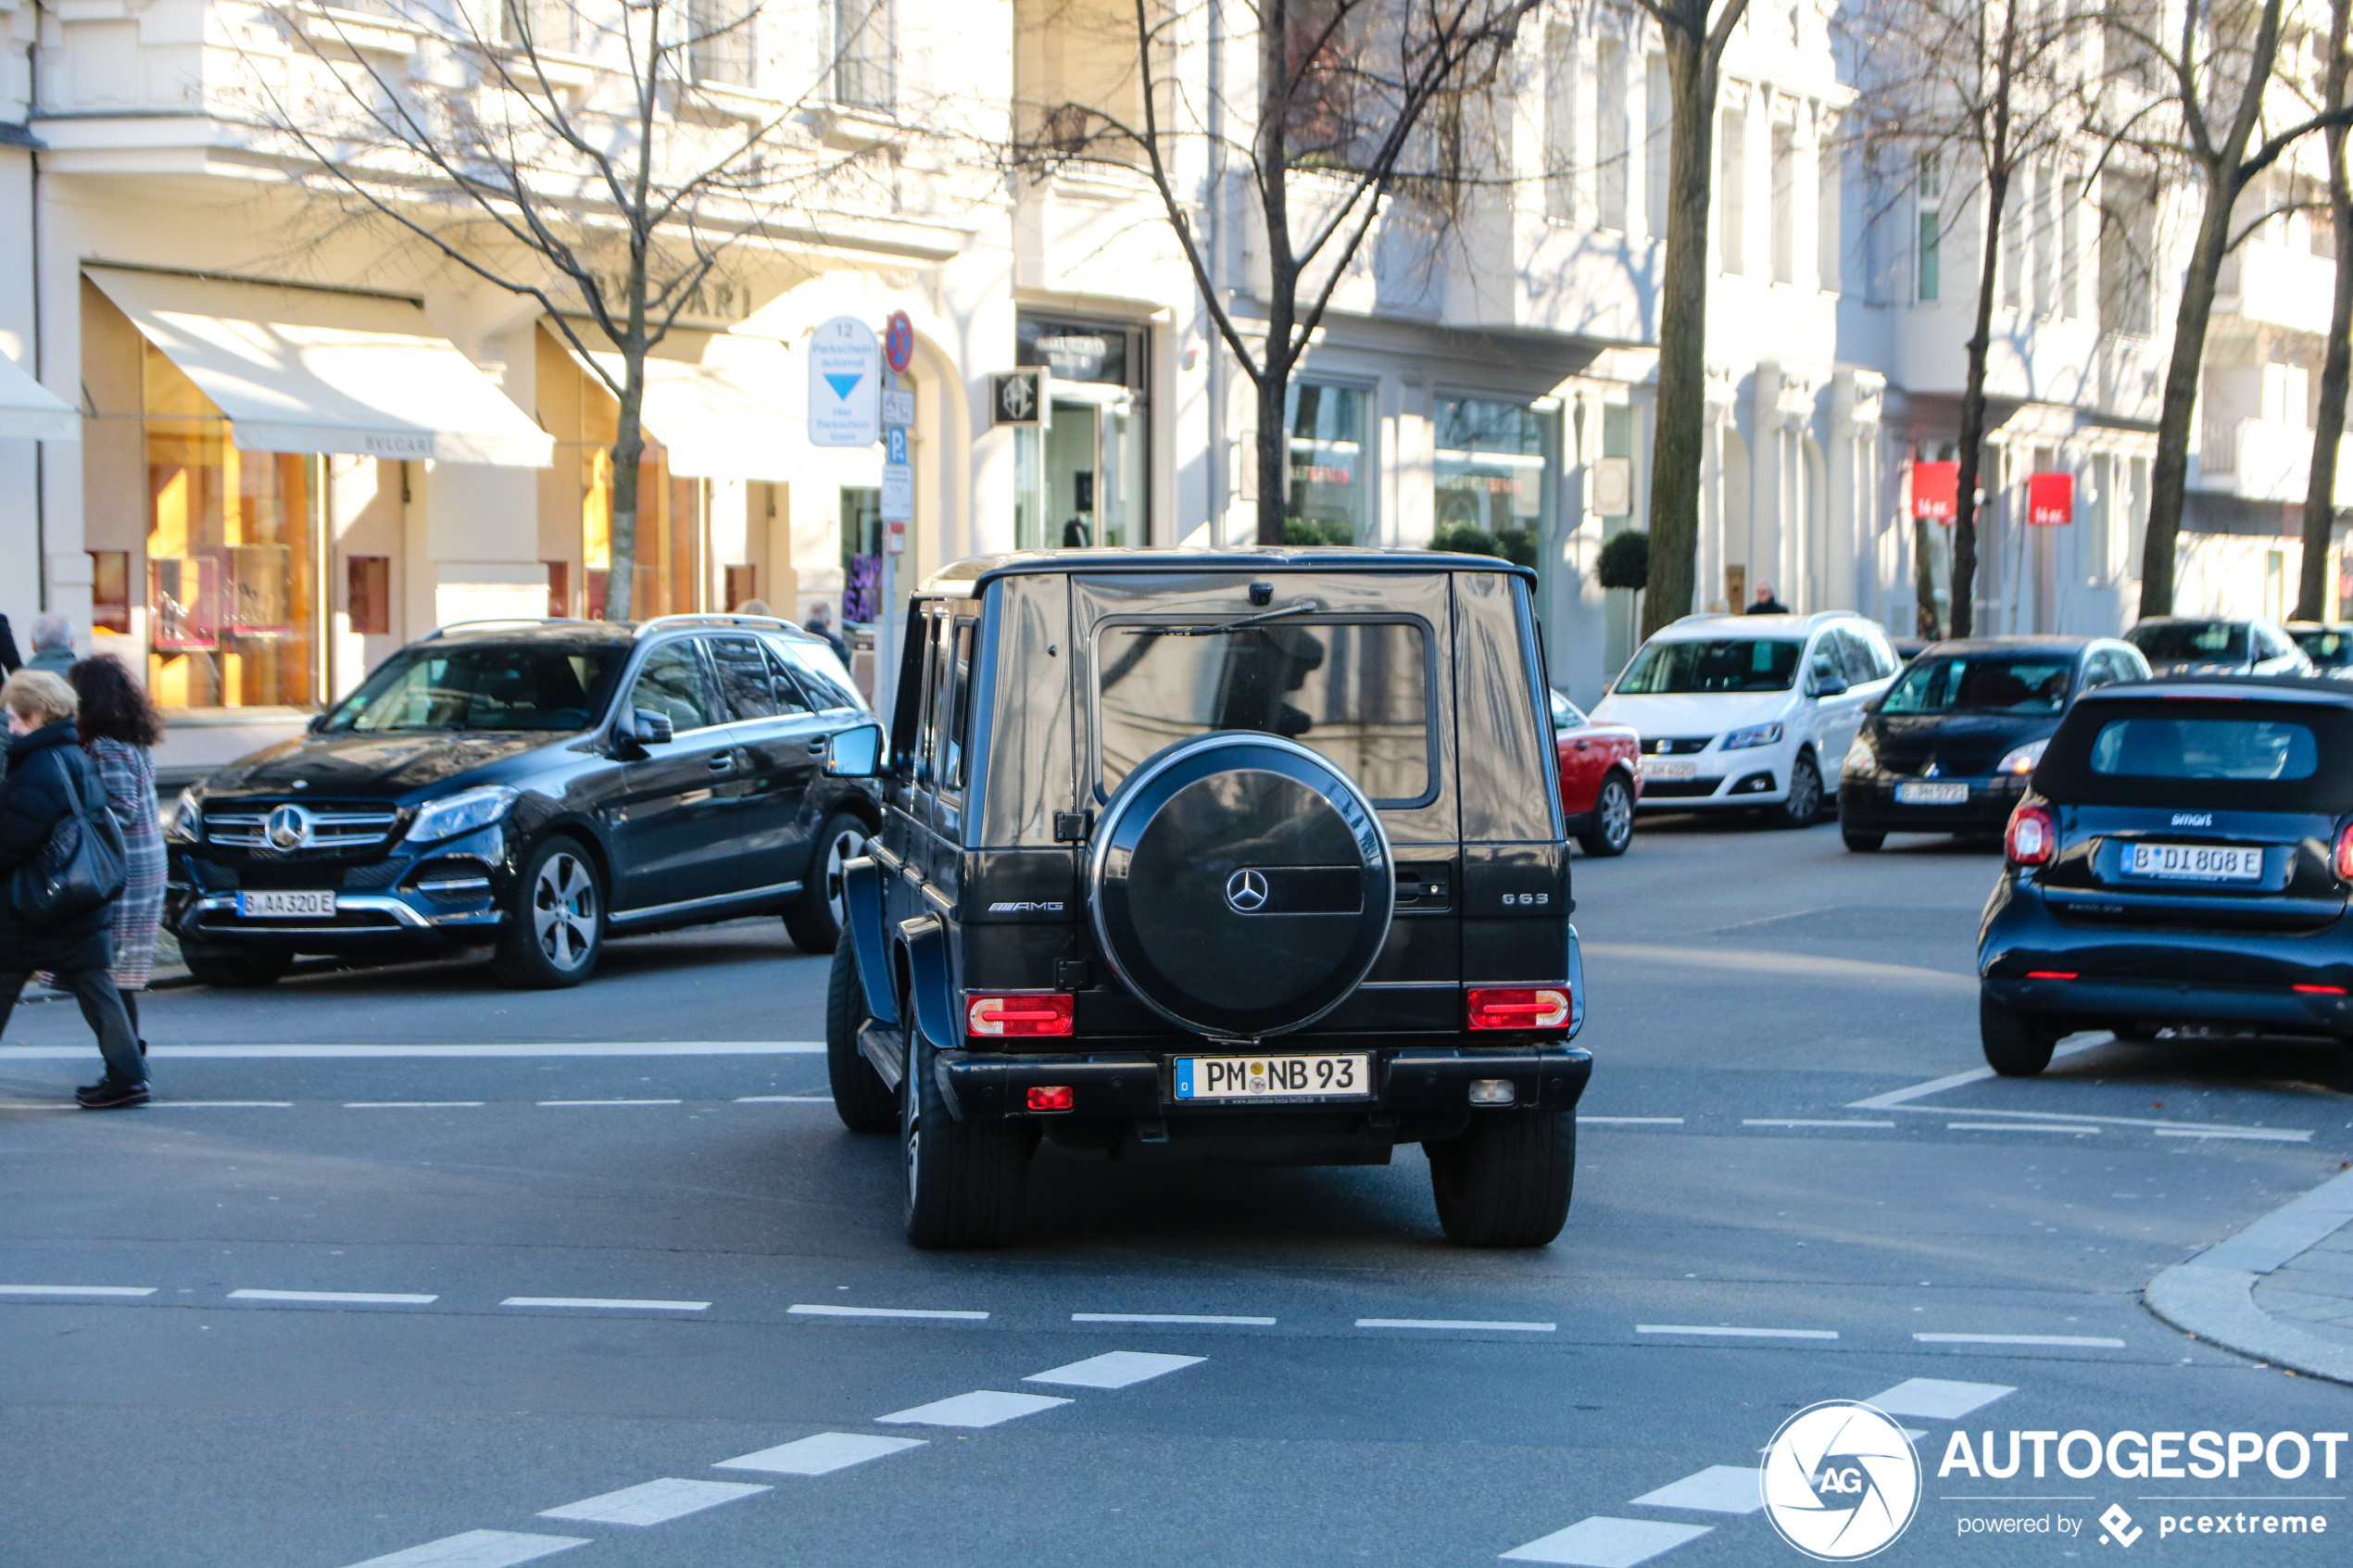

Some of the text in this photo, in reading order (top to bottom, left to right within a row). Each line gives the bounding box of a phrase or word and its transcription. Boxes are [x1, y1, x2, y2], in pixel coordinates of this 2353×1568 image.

[835, 323, 853, 337] 12
[365, 435, 434, 453] BVLGARI
[891, 429, 904, 461] P
[2171, 813, 2213, 826] smart
[2136, 847, 2148, 868] B
[245, 895, 256, 912] B
[1013, 901, 1063, 910] AMG
[1206, 1059, 1353, 1091] PM NB 93
[1181, 1082, 1189, 1091] D
[1232, 1096, 1315, 1105] www.mercedes-benz-berlin.de
